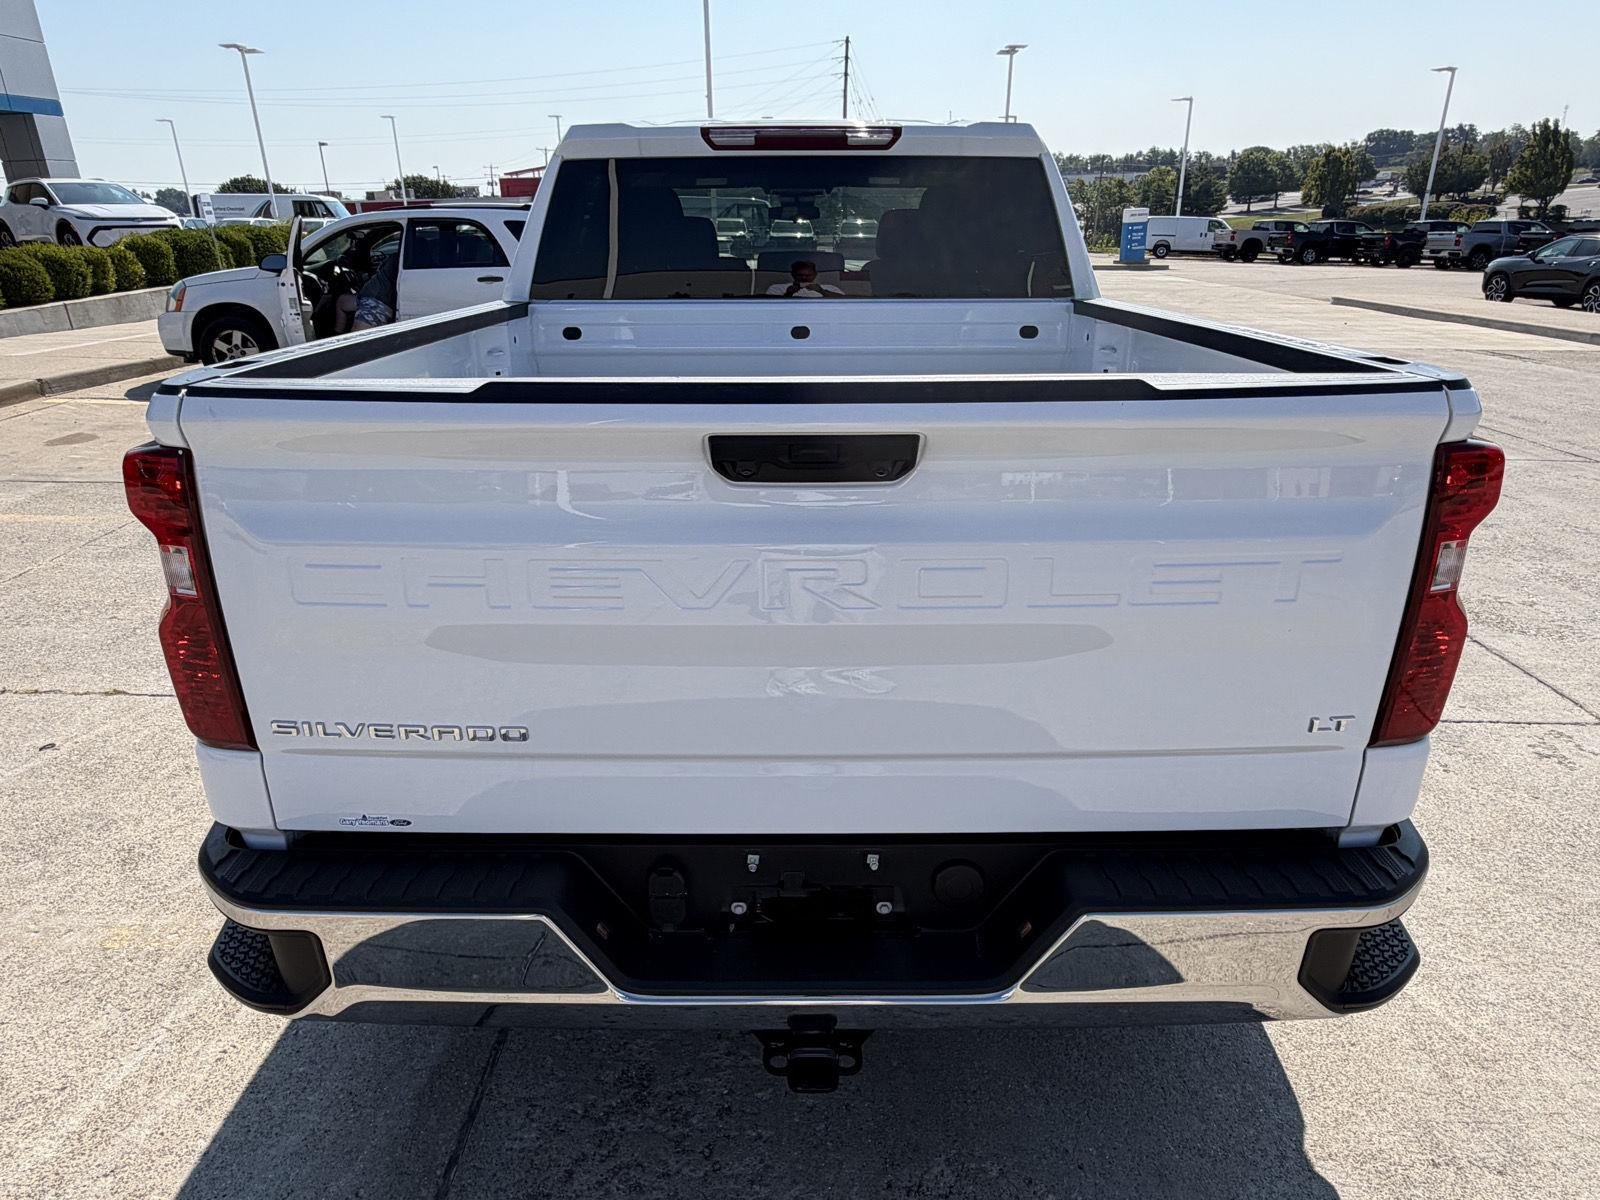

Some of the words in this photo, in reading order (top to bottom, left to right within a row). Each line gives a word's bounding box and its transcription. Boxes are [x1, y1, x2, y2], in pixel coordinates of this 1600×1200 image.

[289, 552, 1344, 612] CHEVROLET
[270, 719, 530, 742] SILVERADO
[1307, 714, 1356, 733] LT
